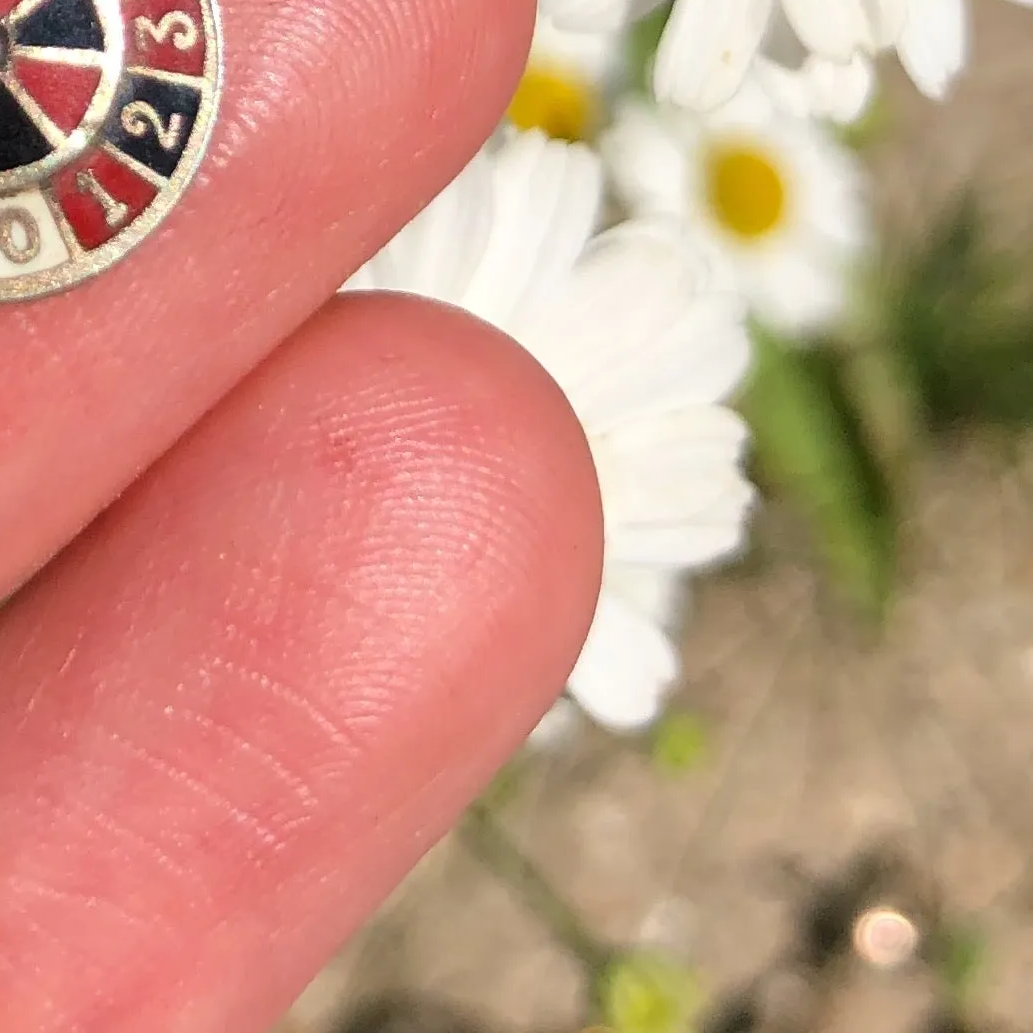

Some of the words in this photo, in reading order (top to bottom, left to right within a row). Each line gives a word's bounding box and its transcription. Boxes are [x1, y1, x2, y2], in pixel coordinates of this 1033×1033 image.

[133, 10, 198, 51] 3
[121, 99, 183, 150] 2
[76, 168, 129, 228] 1
